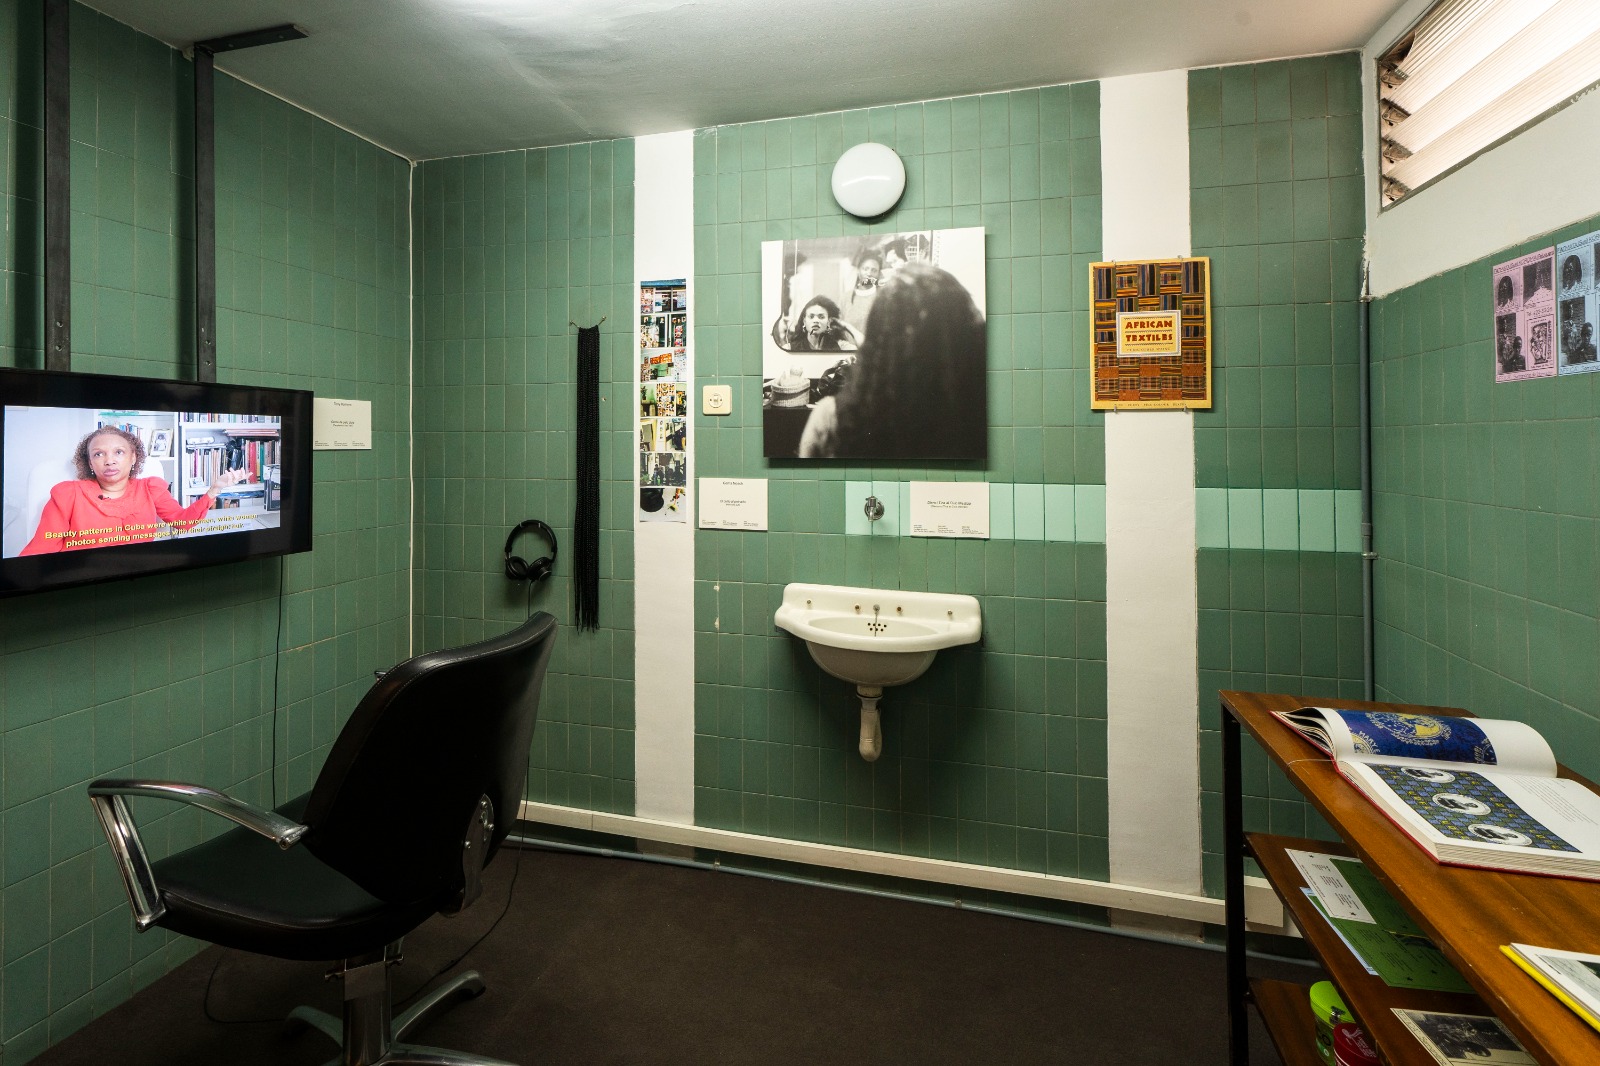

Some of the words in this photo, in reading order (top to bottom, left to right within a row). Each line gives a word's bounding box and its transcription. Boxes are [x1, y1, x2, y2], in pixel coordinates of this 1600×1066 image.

[1125, 320, 1173, 329] AFRICAN
[1126, 333, 1173, 342] TEXTILES
[45, 529, 77, 539] Beauty
[79, 527, 113, 537] patterns
[124, 523, 145, 531] Cuba
[167, 519, 187, 527] white
[66, 537, 97, 548] photos
[98, 534, 131, 544] sending
[132, 530, 171, 540] messages
